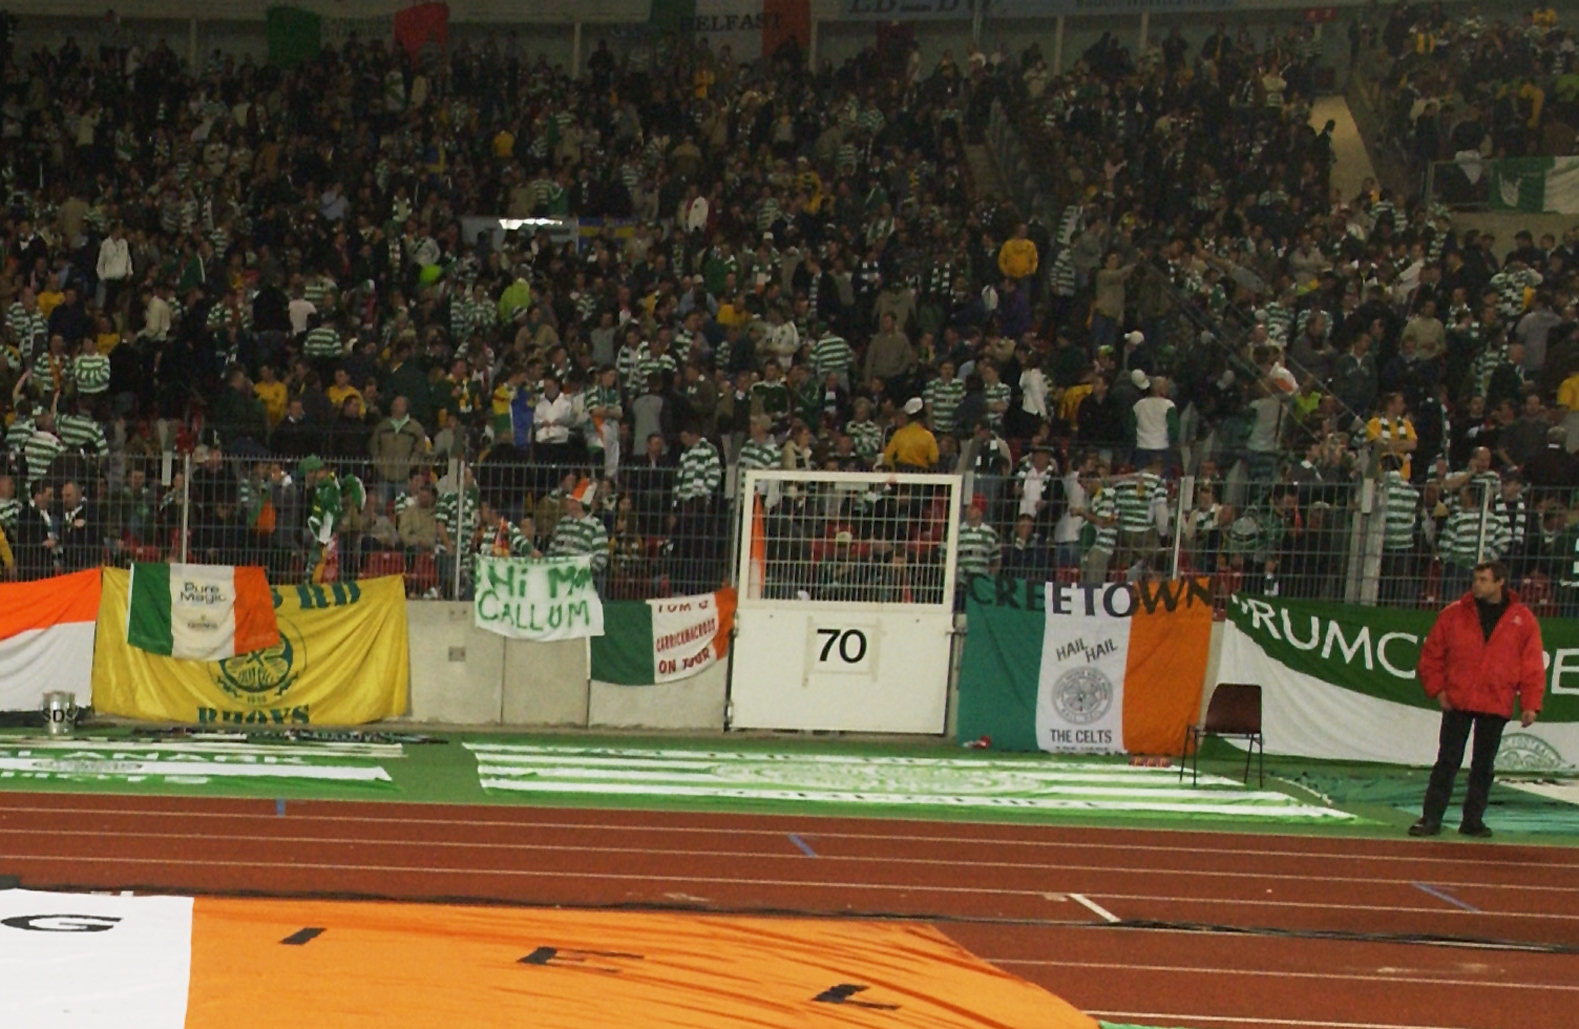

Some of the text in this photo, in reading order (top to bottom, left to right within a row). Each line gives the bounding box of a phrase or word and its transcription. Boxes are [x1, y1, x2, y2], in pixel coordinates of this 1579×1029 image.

[478, 589, 590, 631] CALLUM
[967, 571, 1215, 618] CREETOWN
[816, 627, 868, 664] 70
[1056, 637, 1119, 663] HAIL HAIL
[658, 658, 677, 674] ON
[1049, 728, 1113, 744] THE CELTS
